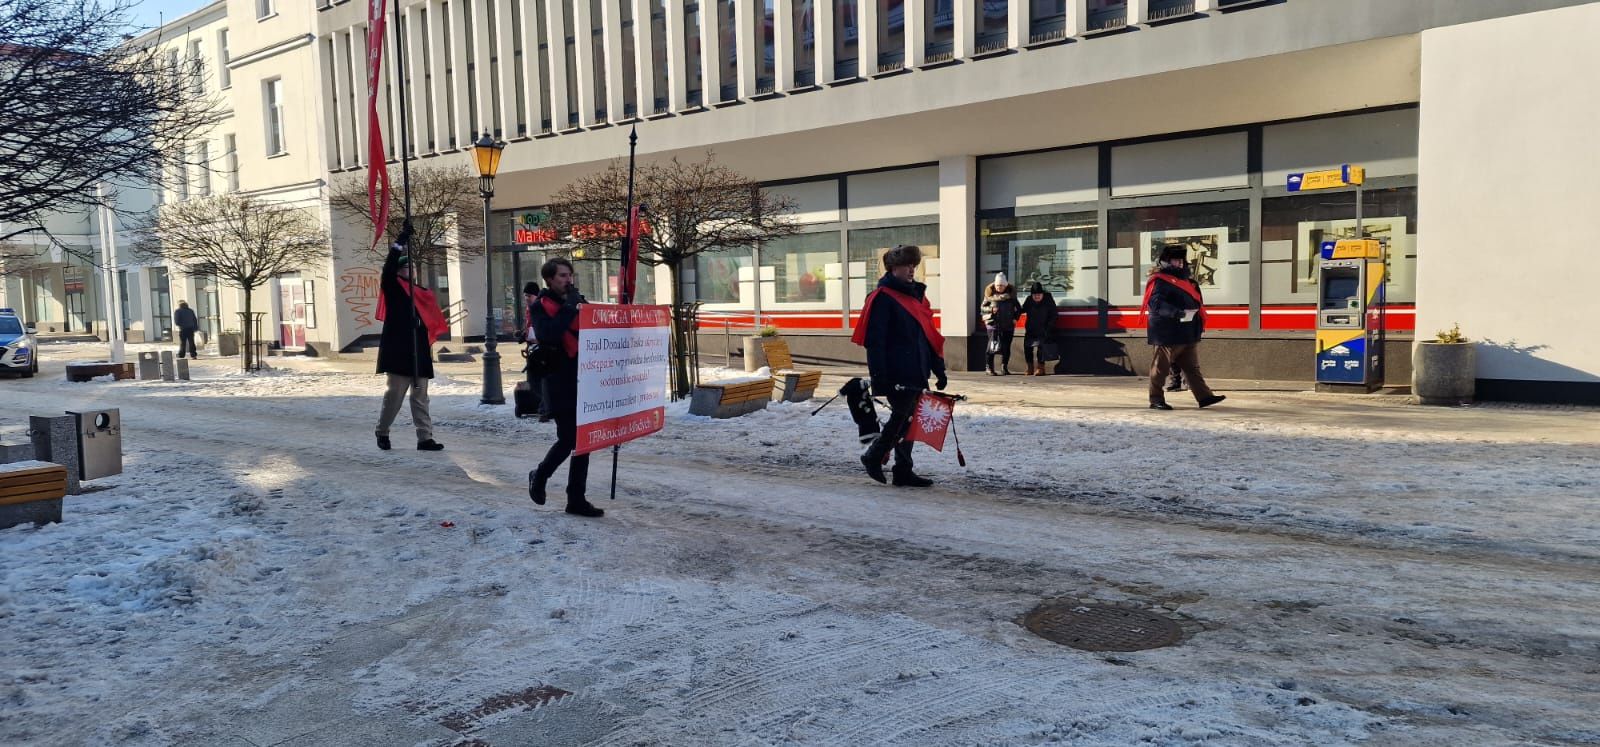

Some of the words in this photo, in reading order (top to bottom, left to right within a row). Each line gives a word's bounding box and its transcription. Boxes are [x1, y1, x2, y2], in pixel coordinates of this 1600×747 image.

[592, 308, 627, 324] UWAGA
[586, 338, 601, 353] Rząd
[603, 337, 629, 350] Donalda
[583, 399, 614, 414] Przeczytaj
